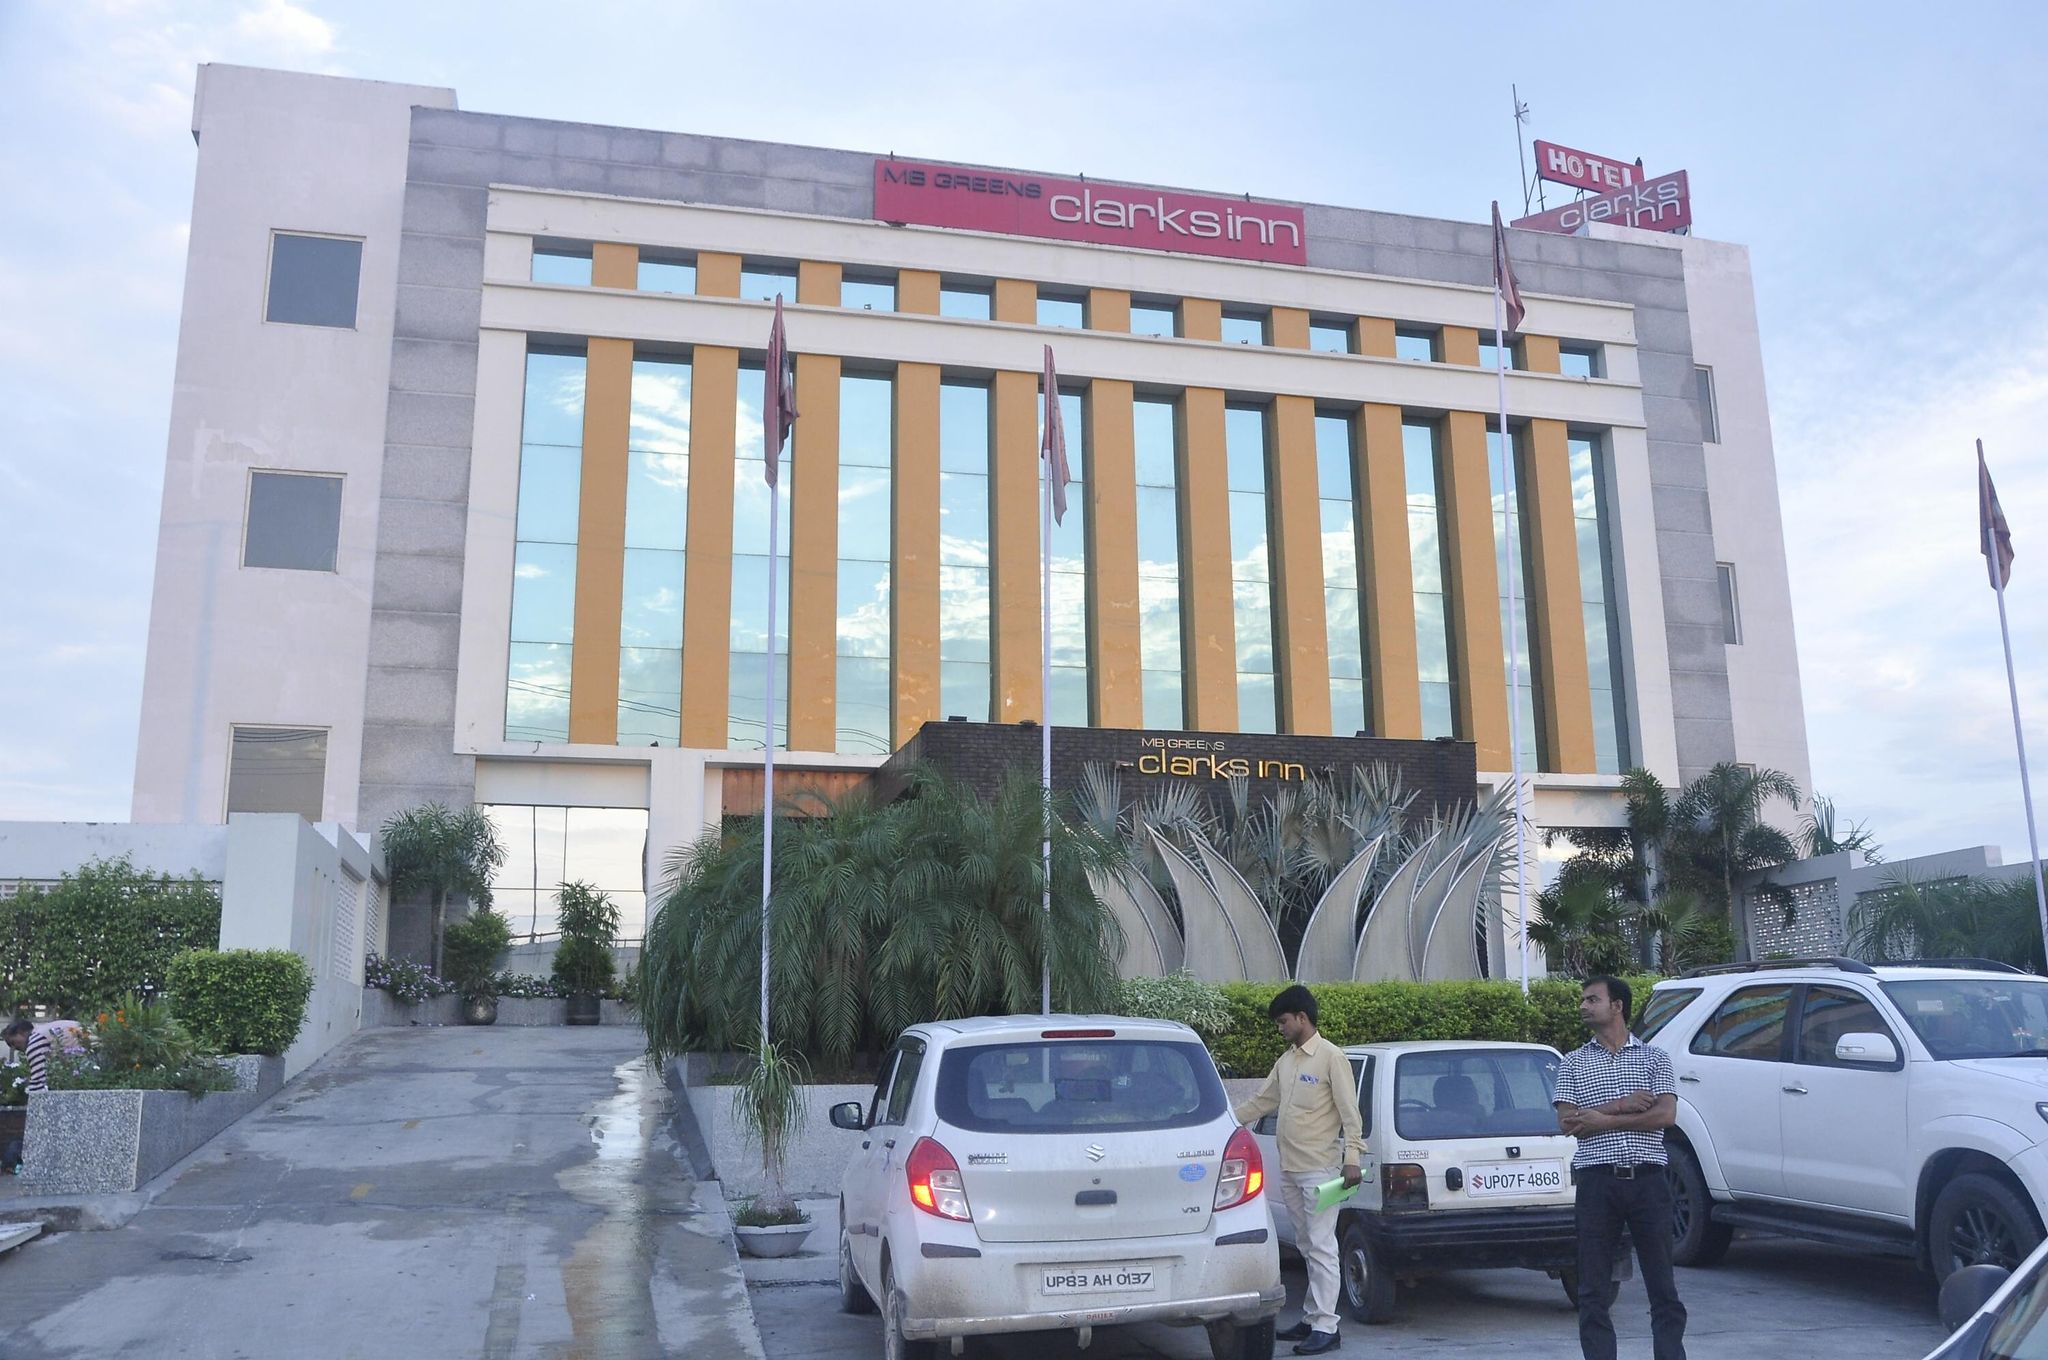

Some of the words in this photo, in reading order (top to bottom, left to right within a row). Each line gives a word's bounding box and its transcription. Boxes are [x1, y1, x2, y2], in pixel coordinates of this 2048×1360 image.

[934, 172, 1042, 199] GREENS
[1560, 181, 1679, 228] clarks
[1625, 199, 1681, 228] inn
[1141, 737, 1165, 748] MB
[1167, 738, 1225, 751] GREENS
[1138, 748, 1250, 780] clarks
[1528, 1171, 1560, 1187] 4868
[1046, 1275, 1088, 1287] UP83
[1093, 1274, 1112, 1287] AH
[1116, 1272, 1151, 1286] 0137
